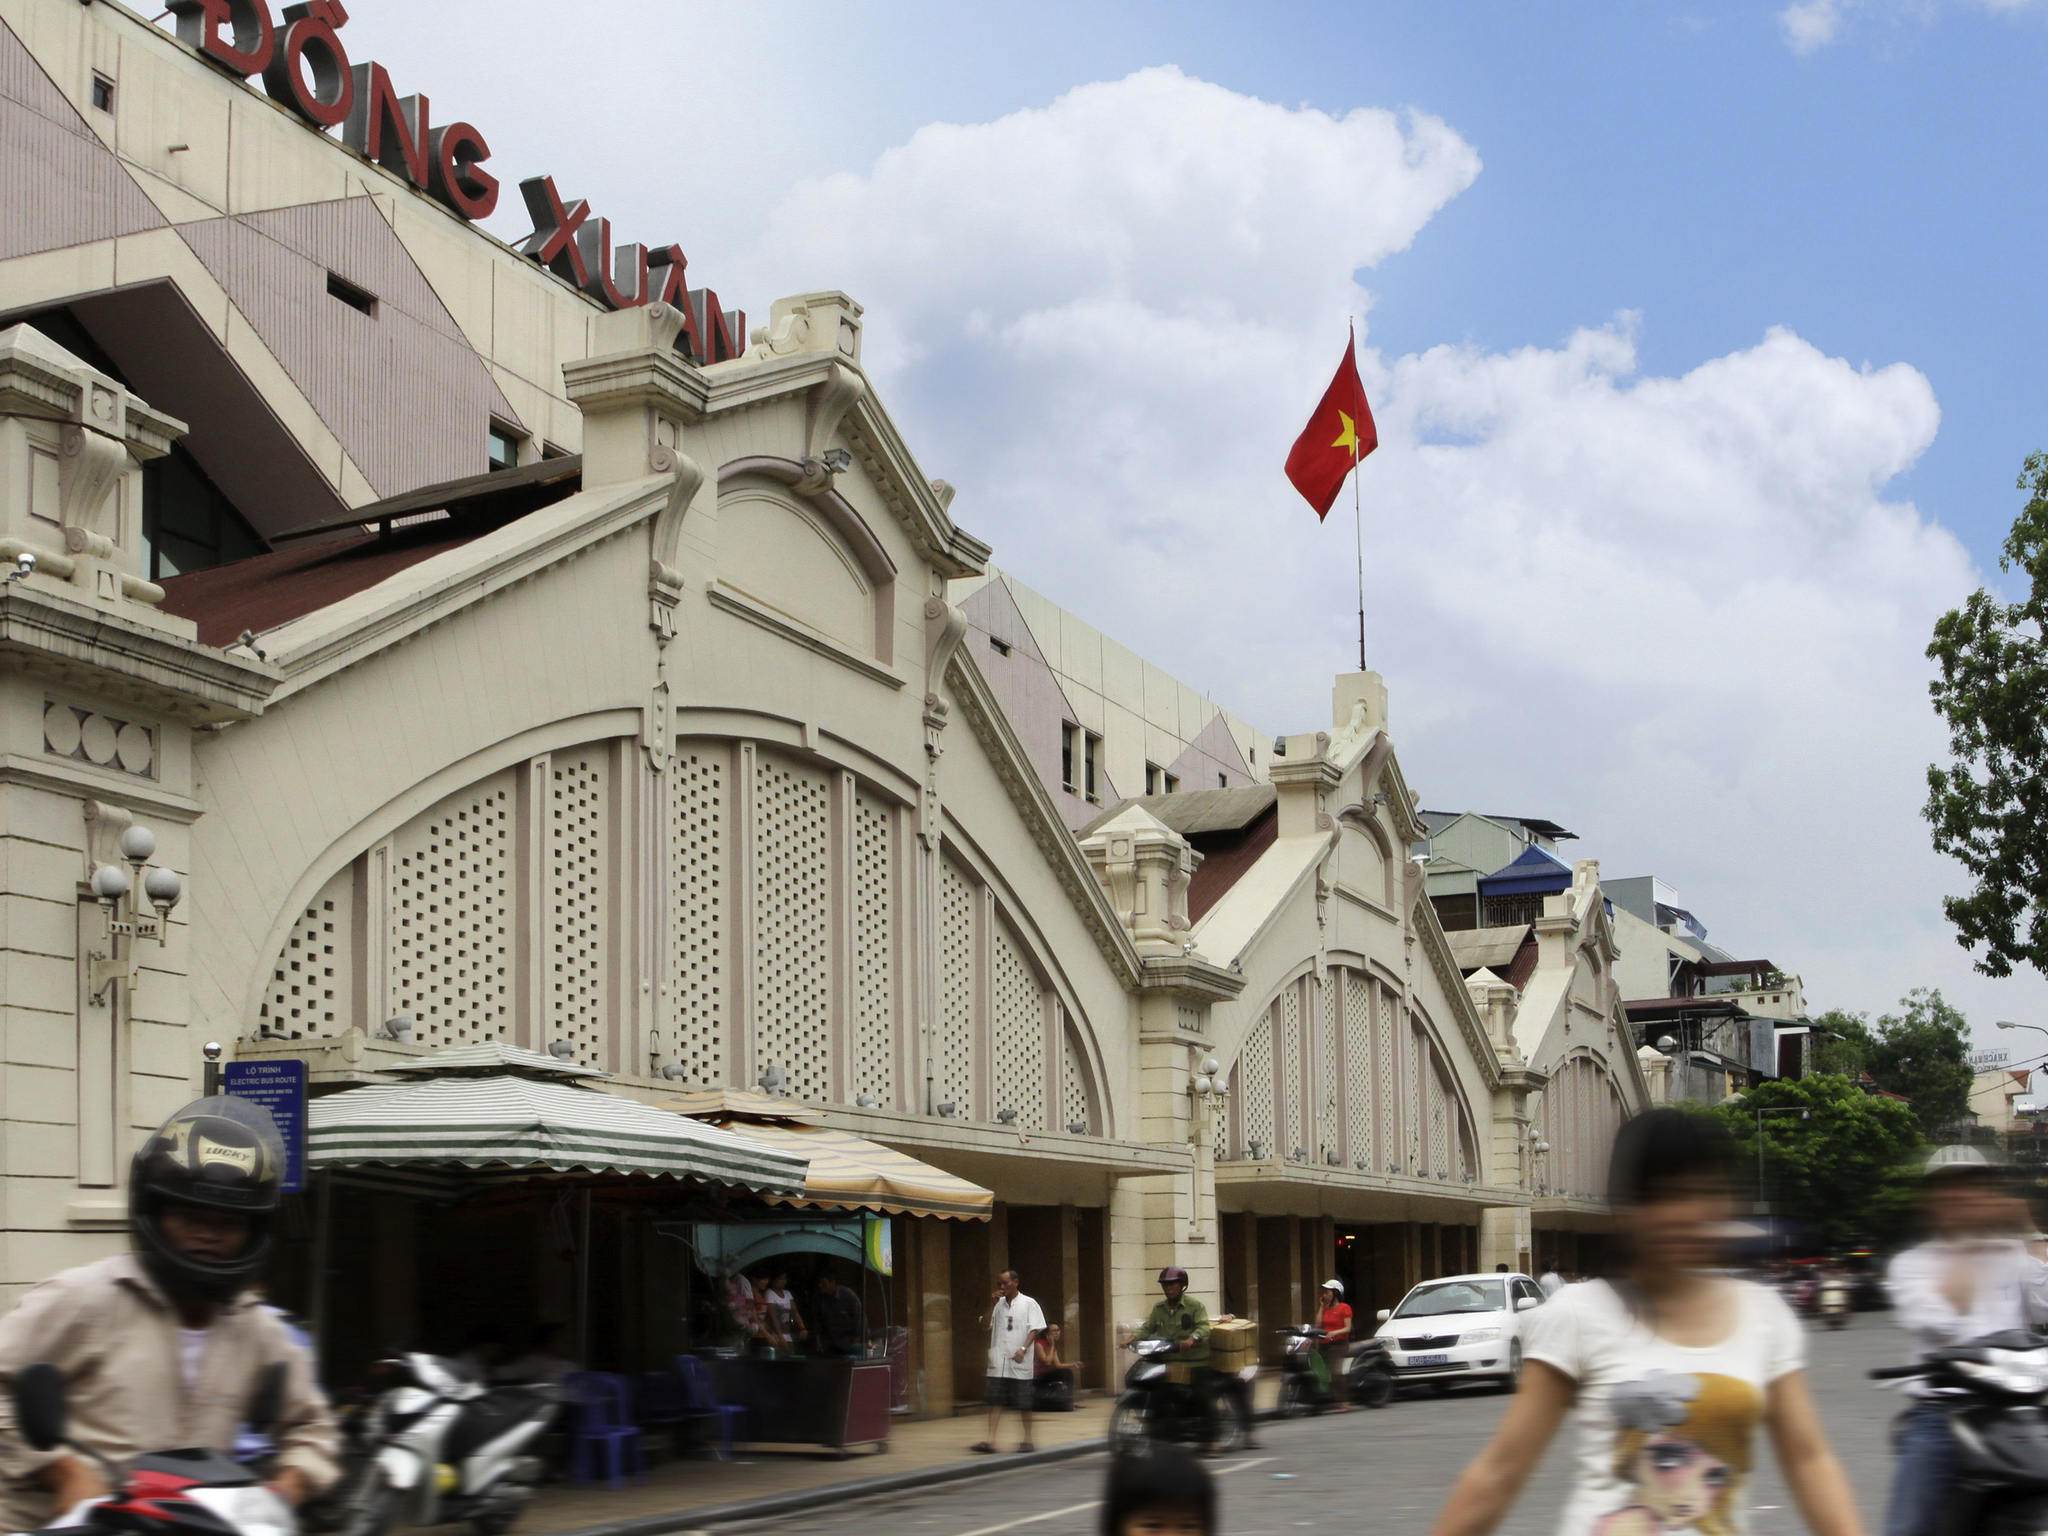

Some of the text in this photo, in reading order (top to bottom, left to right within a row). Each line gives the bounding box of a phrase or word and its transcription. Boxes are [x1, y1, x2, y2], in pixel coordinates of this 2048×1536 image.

[519, 175, 747, 367] XUÂN
[275, 1076, 297, 1084] ROUTE
[205, 1147, 250, 1161] LUCKY
